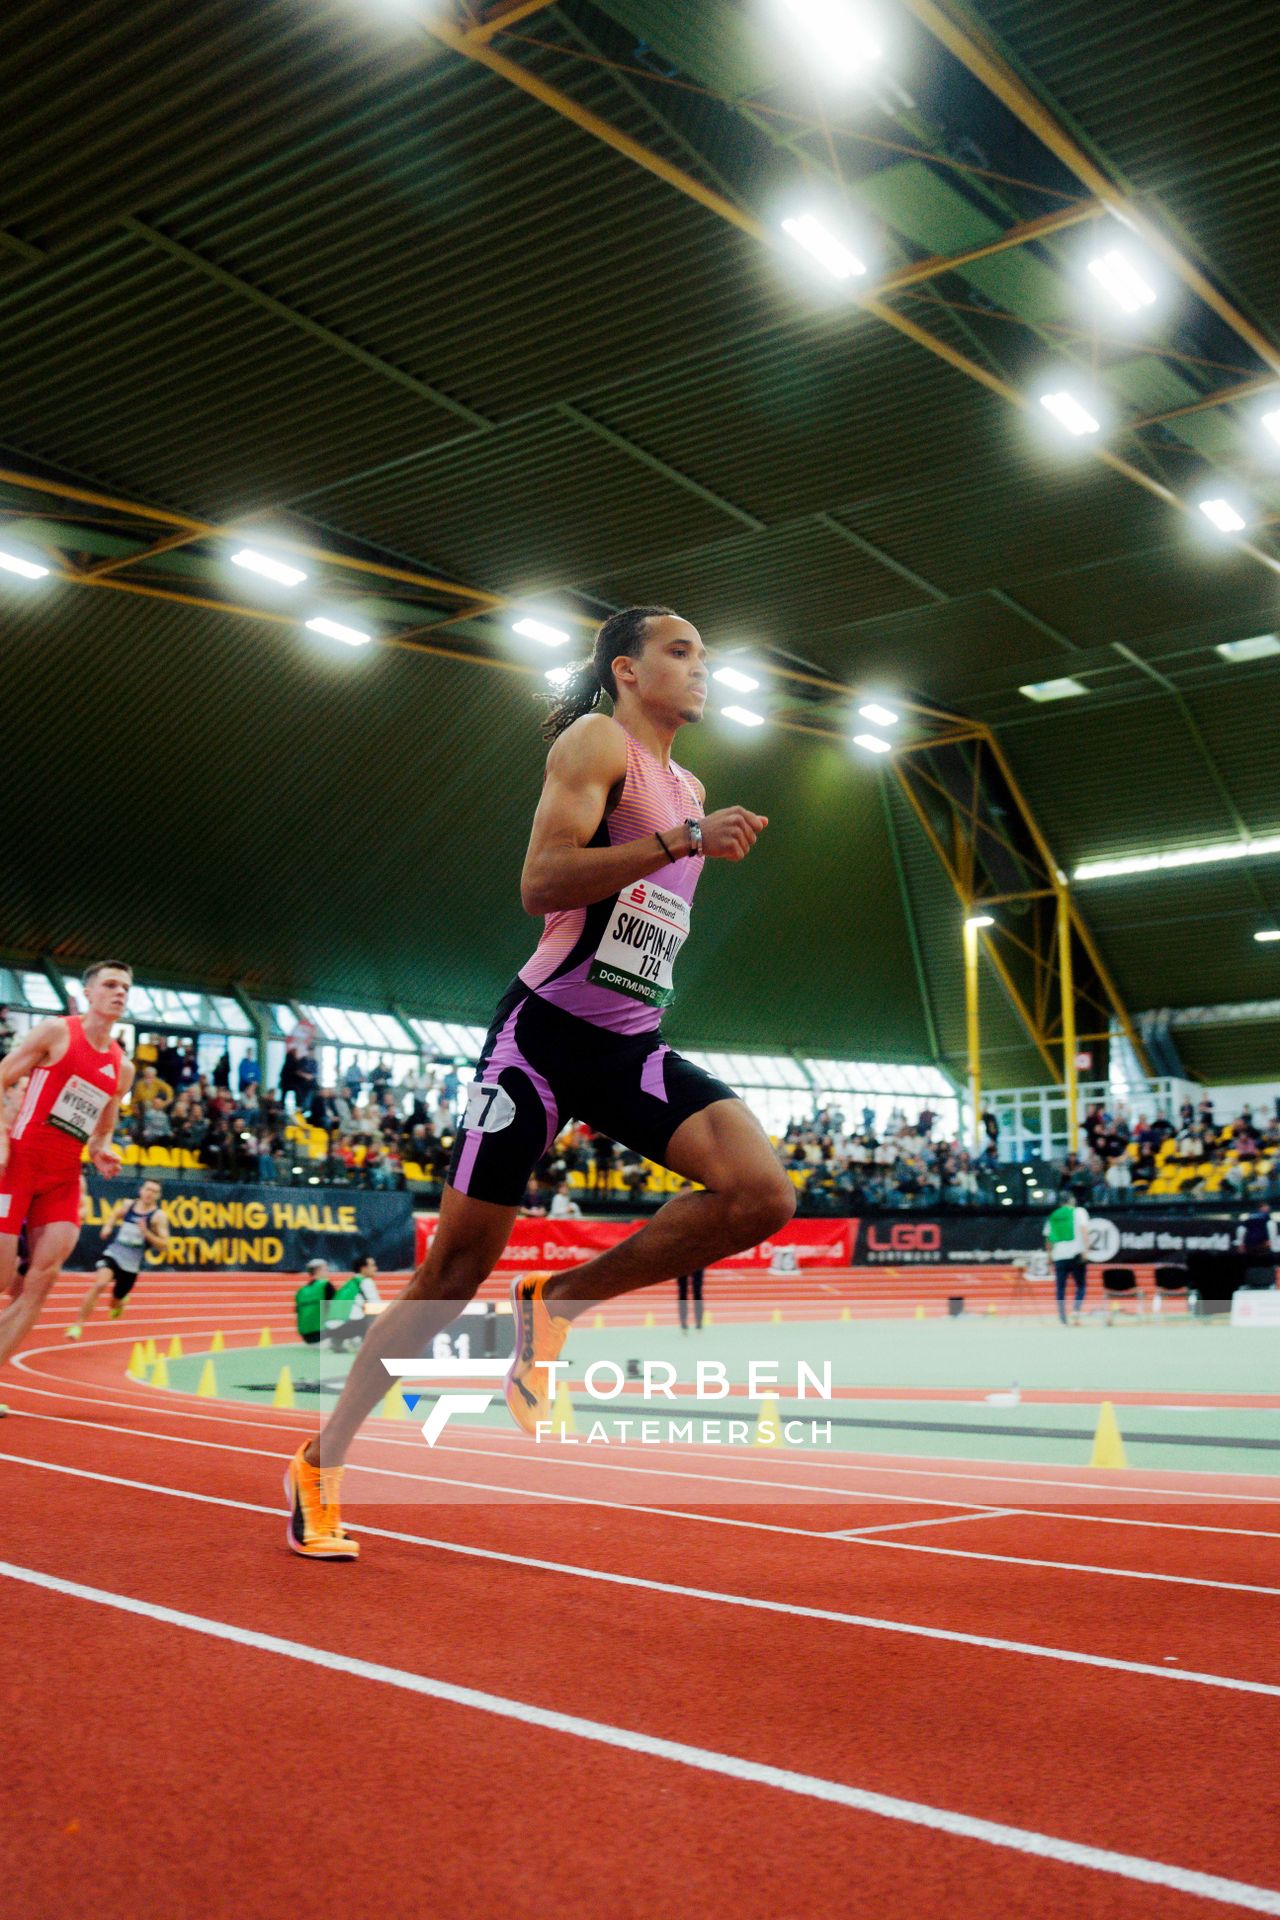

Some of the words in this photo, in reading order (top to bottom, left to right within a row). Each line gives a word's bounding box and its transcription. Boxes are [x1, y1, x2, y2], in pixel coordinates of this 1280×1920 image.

[647, 900, 676, 919] Dortmund
[651, 889, 671, 904] Indoor
[639, 954, 661, 982] 174
[599, 969, 651, 996] DORTMUND
[477, 1087, 499, 1127] 7
[273, 1203, 358, 1233] HALLE
[867, 1223, 942, 1251] LGO
